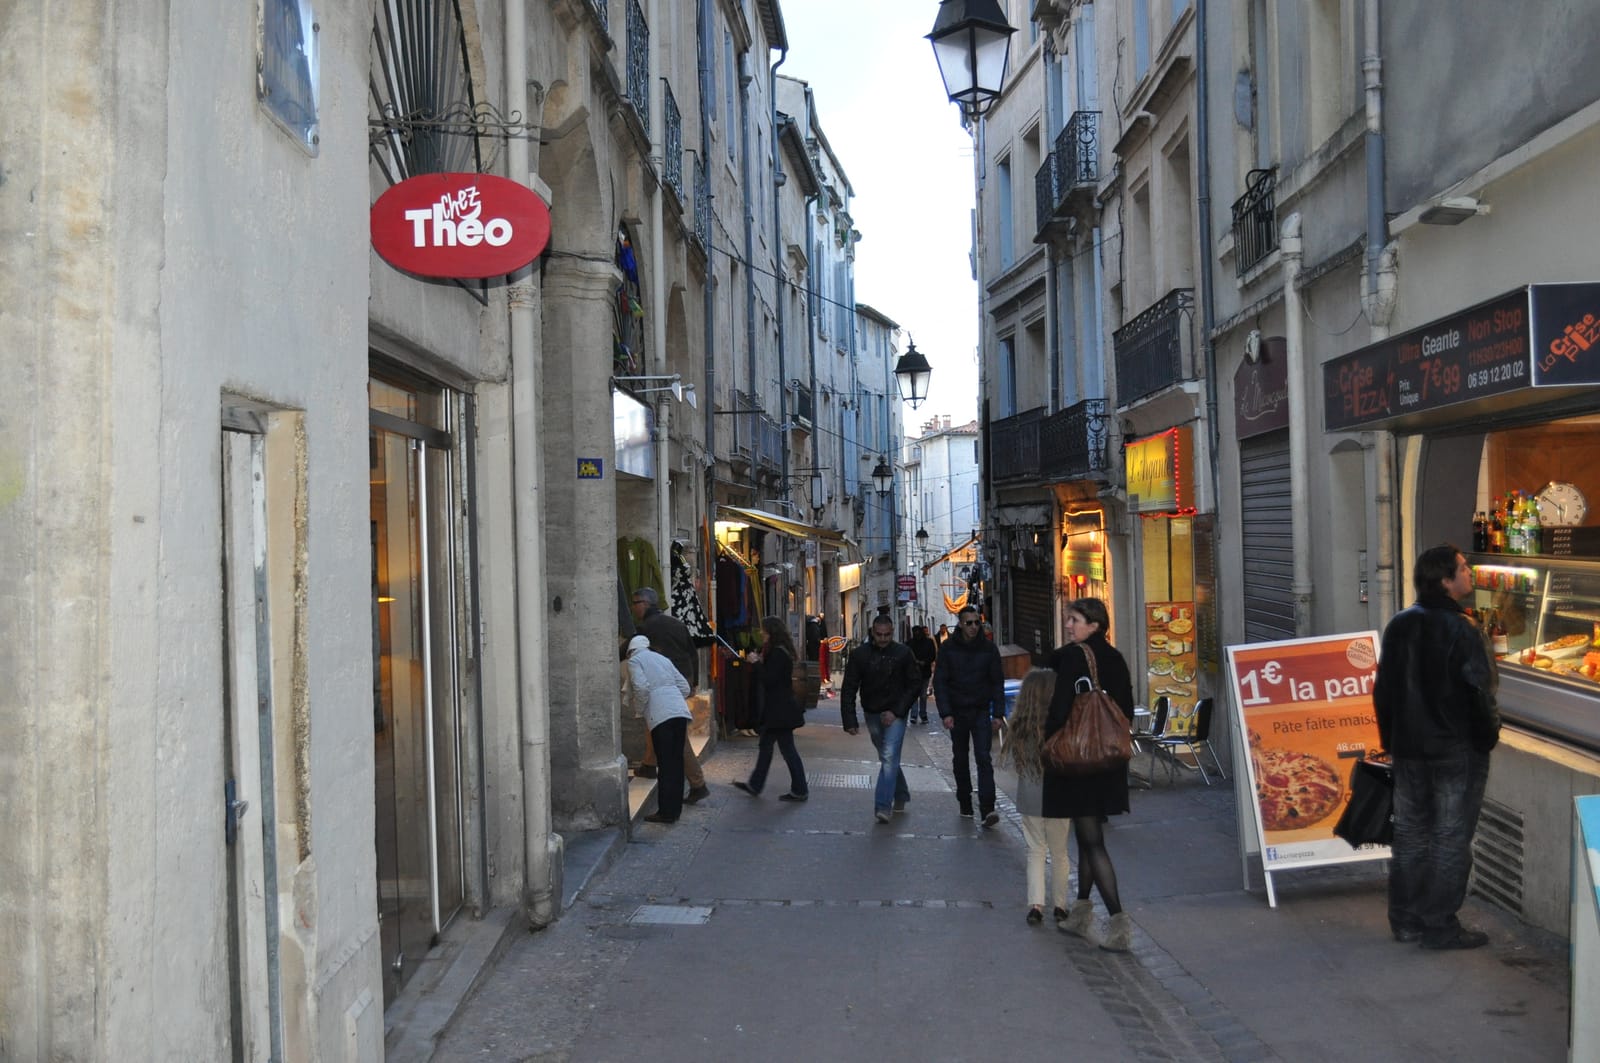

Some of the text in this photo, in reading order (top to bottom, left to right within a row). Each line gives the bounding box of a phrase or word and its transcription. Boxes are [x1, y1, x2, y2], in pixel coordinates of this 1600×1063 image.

[440, 185, 481, 219] Chez
[1467, 308, 1522, 342] Non Stop
[1421, 329, 1460, 357] Geante
[1398, 379, 1410, 393] Prix
[1467, 360, 1524, 389] 06 59 12 20 02
[1399, 392, 1420, 407] Unique
[1240, 660, 1283, 706] 1€
[1289, 677, 1317, 701] la
[1272, 713, 1378, 734] Pâte faite maiso
[1350, 742, 1365, 751] cm
